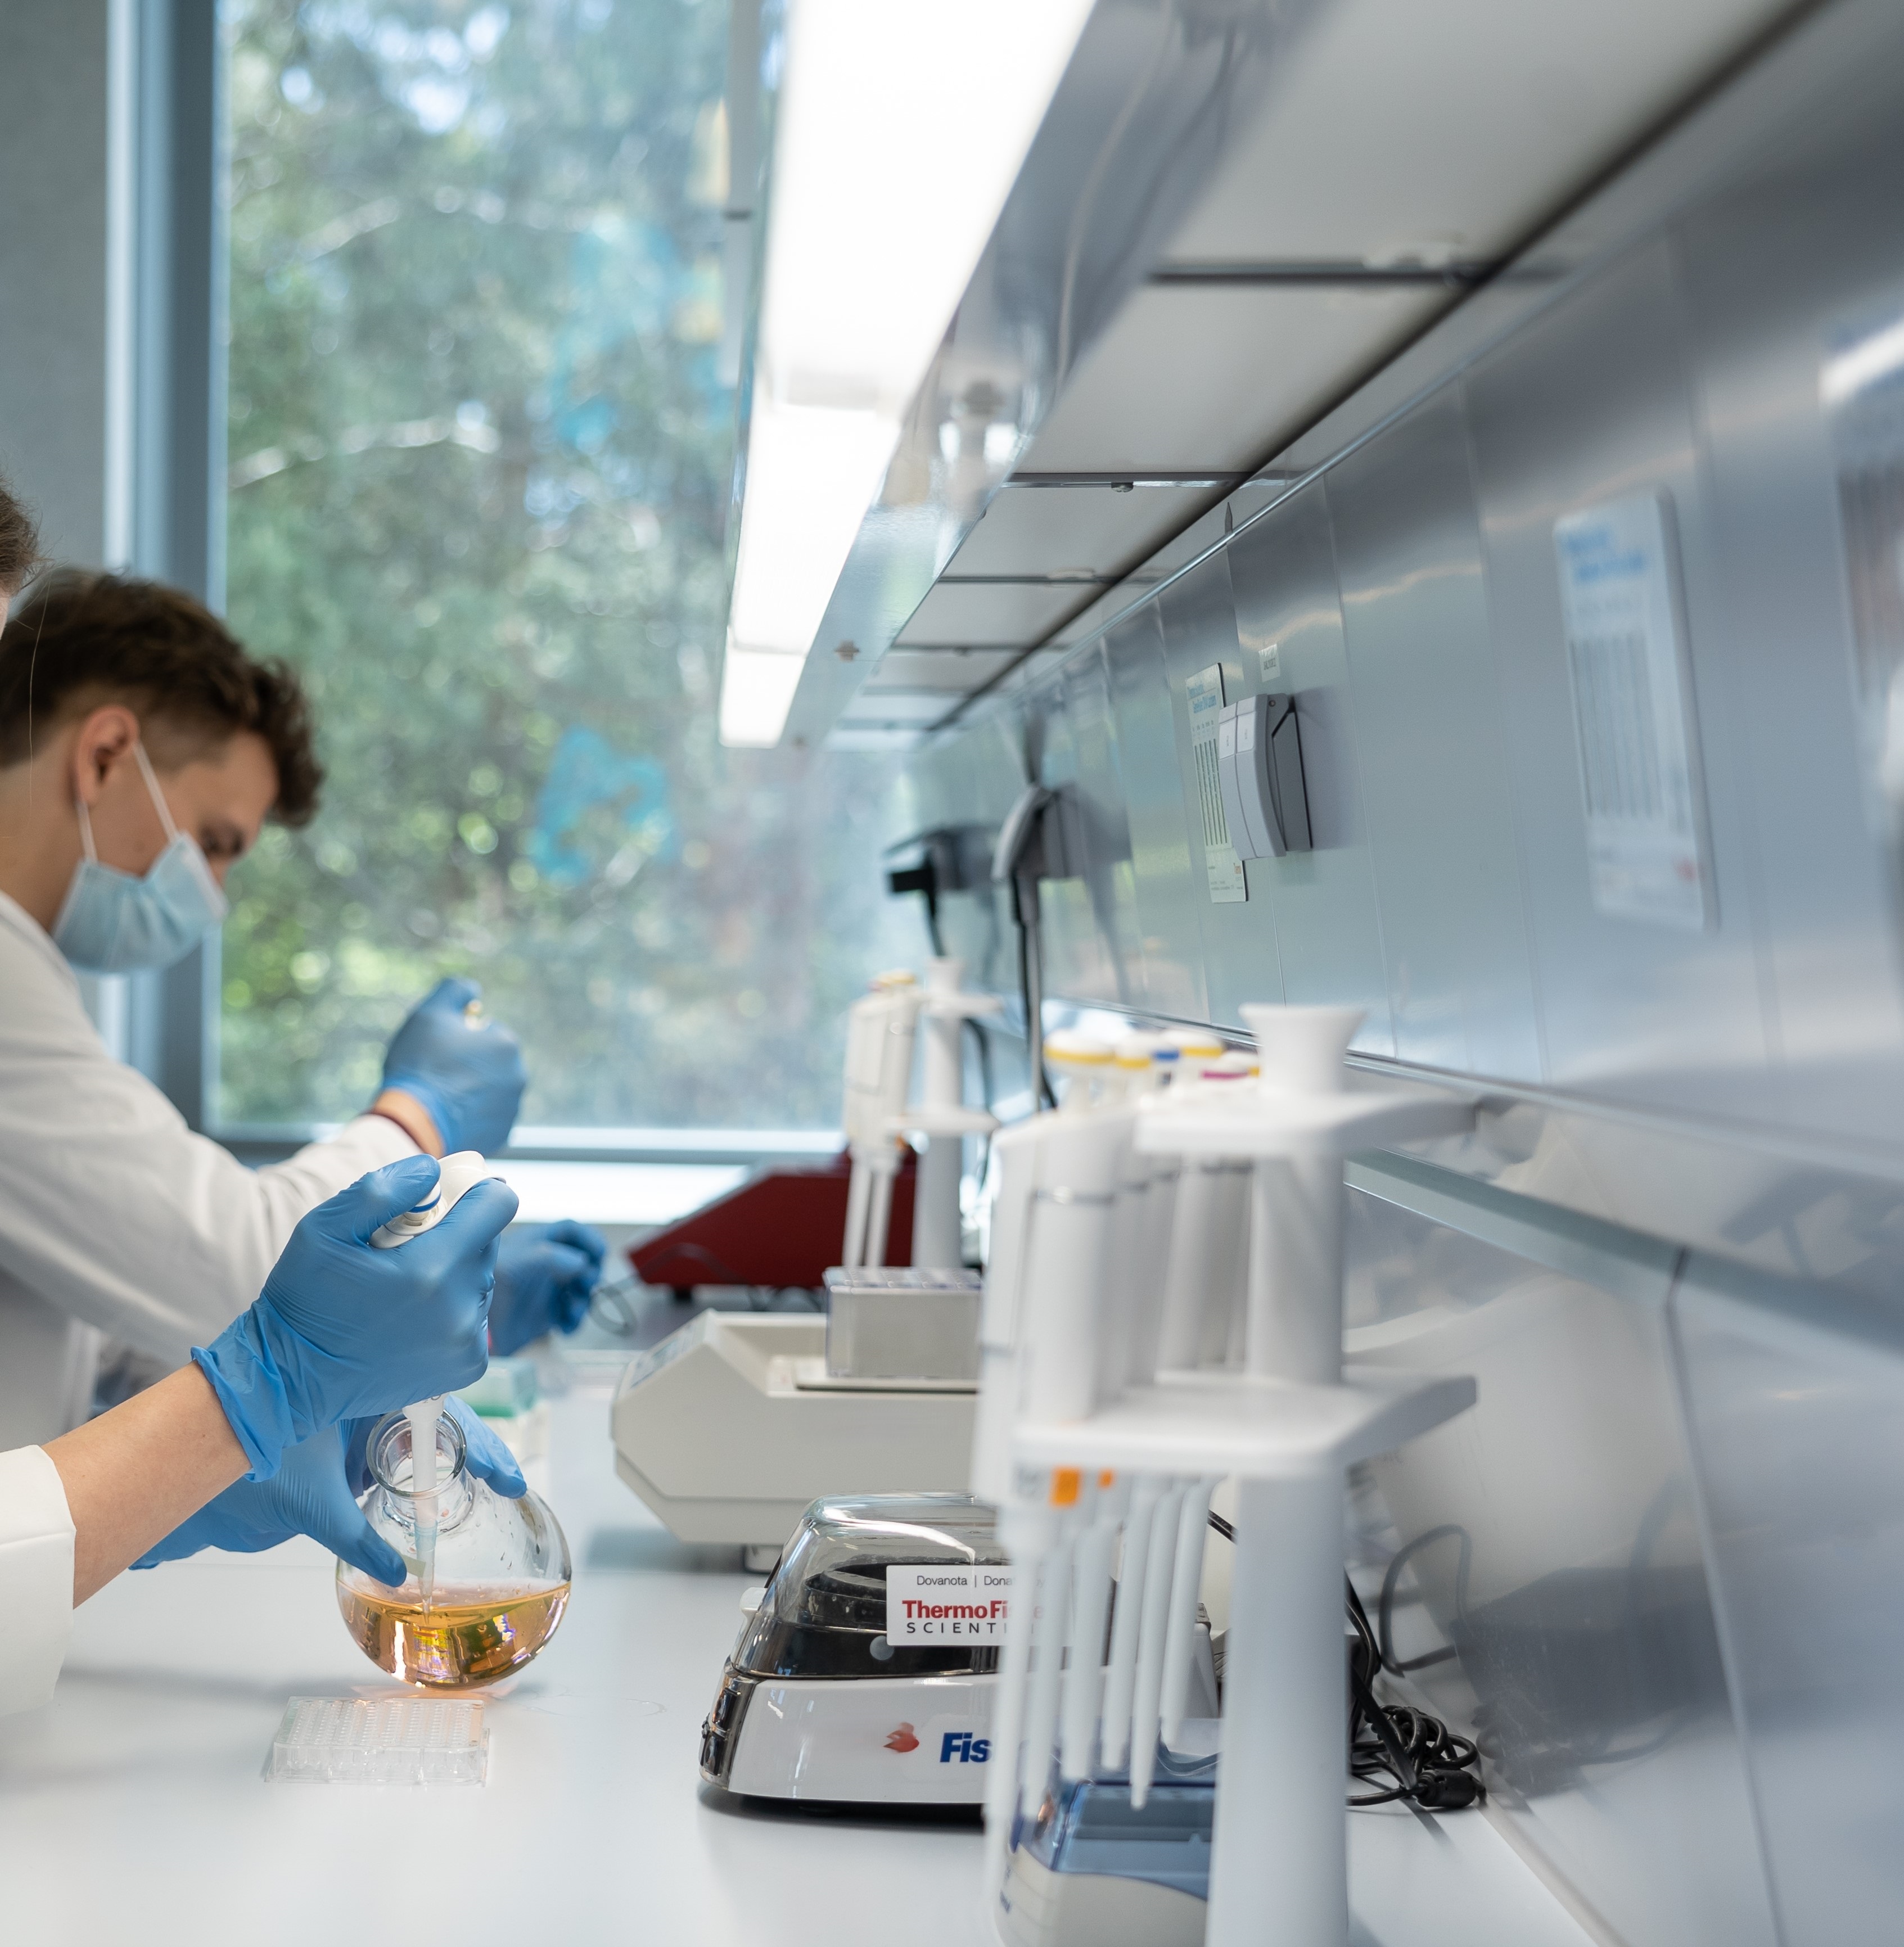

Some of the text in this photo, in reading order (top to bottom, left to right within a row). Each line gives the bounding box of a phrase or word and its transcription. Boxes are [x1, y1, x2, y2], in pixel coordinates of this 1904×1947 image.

[917, 1575, 967, 1585] Dovanota
[984, 1575, 1013, 1585] Dona
[902, 1600, 1044, 1619] ThermoFie
[906, 1622, 1034, 1634] SCIENTII
[940, 1732, 992, 1763] Fis
